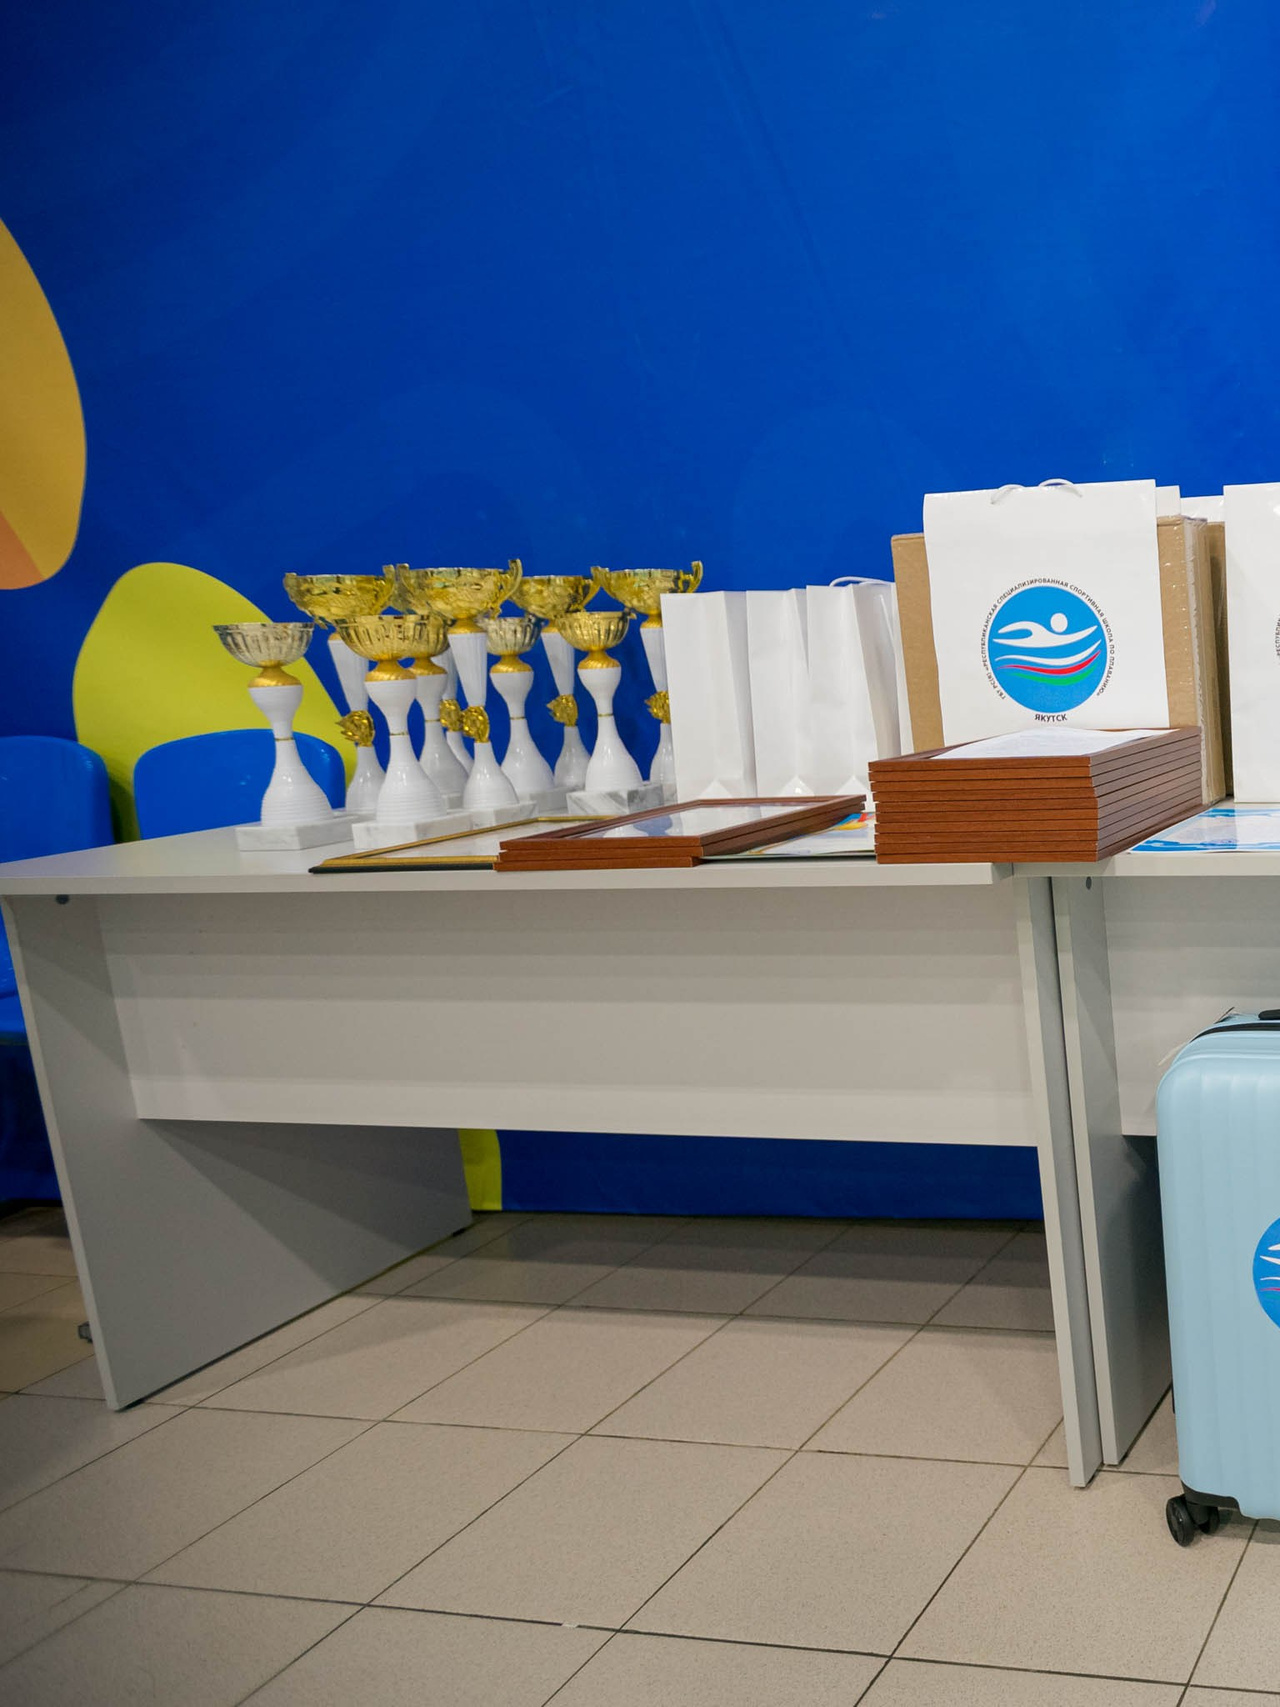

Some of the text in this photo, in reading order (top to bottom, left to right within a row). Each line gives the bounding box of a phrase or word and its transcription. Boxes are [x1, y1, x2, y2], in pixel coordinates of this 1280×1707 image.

[996, 578, 1069, 604] СПЕЦИАЛИЗИРОВАННАЯ
[1069, 584, 1105, 618] СПОРТИВНАЯ
[980, 604, 998, 672] «РЕСПУБЛИКАНСКАЯ
[1102, 616, 1114, 643] ШКОЛА
[1109, 644, 1115, 655] ПО
[1096, 657, 1115, 697] ПЛАВАНИЮ»
[1034, 714, 1068, 722] ЯКУТСК
